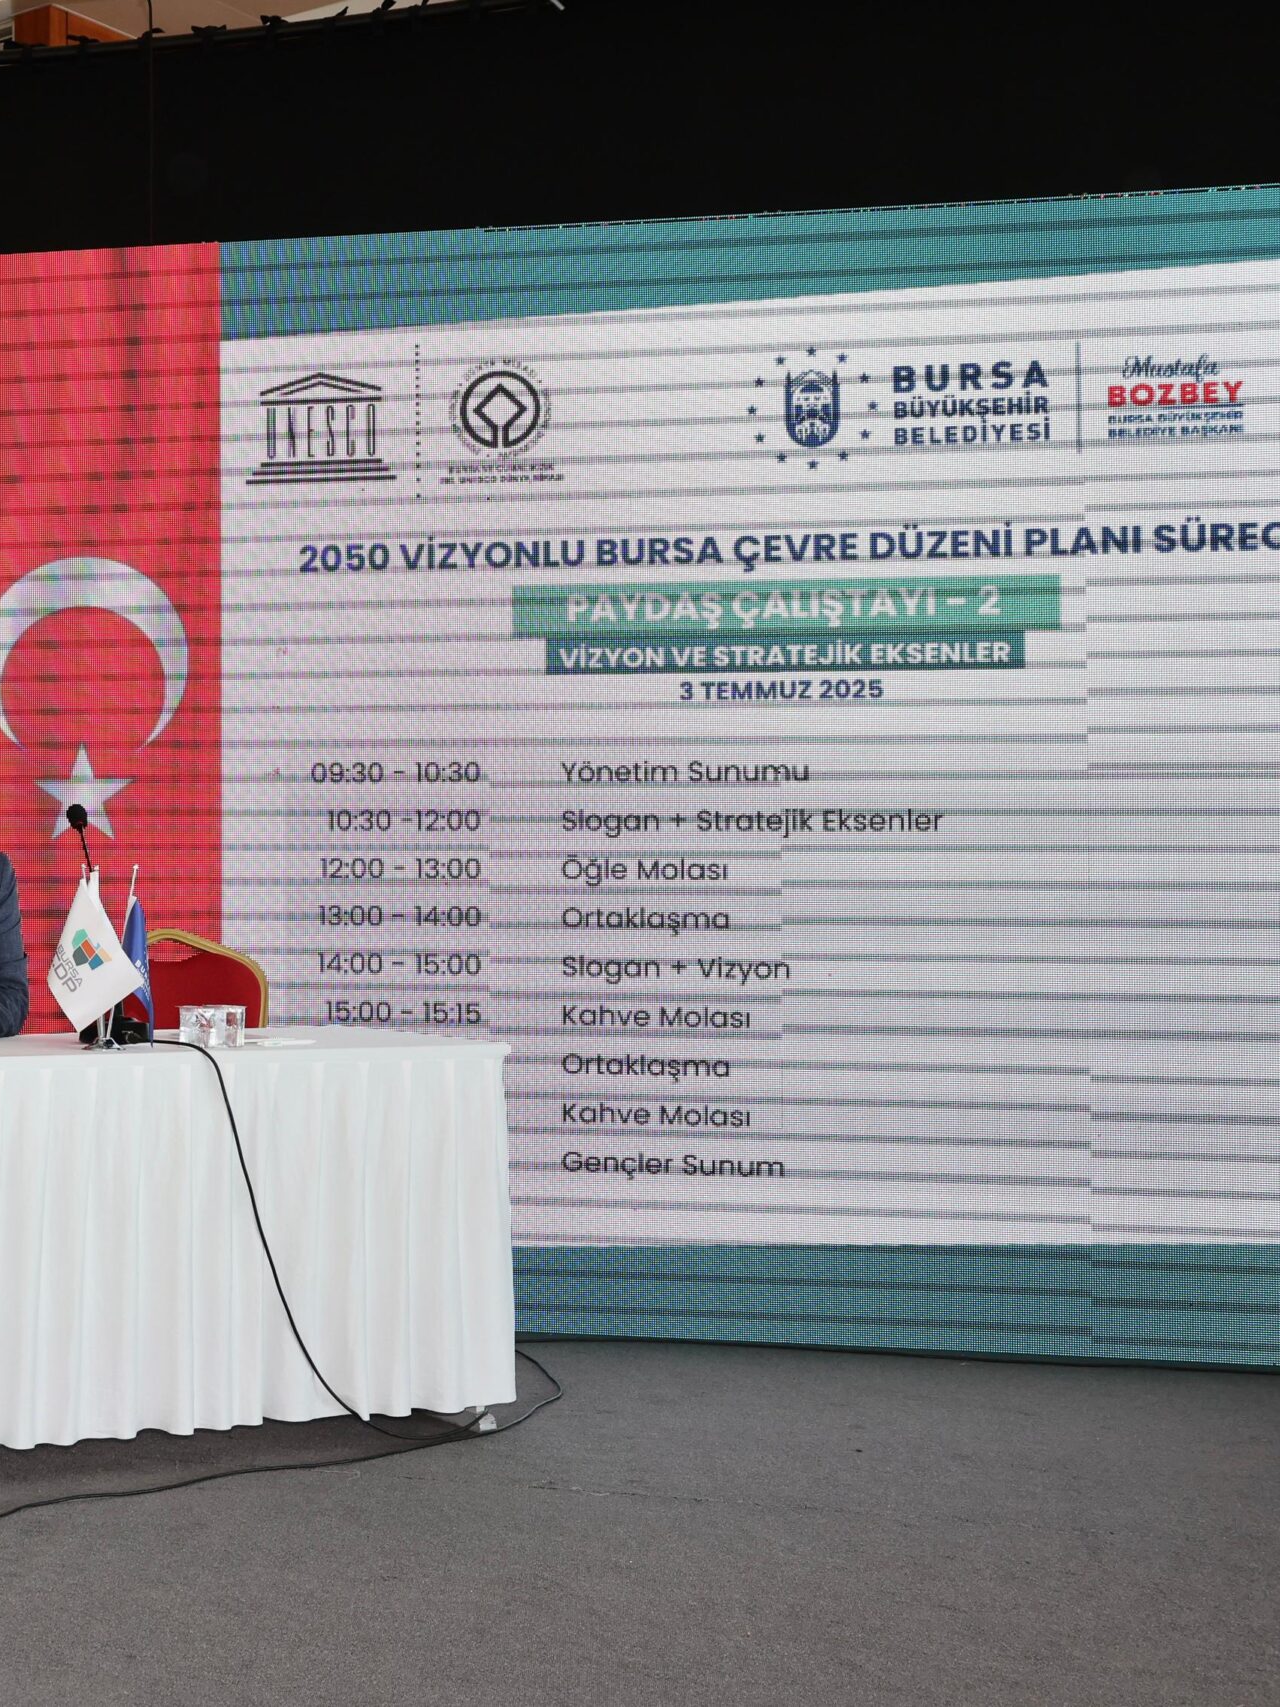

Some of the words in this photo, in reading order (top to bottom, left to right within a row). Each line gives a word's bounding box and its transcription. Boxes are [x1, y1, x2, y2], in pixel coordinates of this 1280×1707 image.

[893, 360, 1049, 393] BURSA
[1122, 353, 1220, 383] Mustafa
[1108, 381, 1244, 407] BOZBEY
[893, 395, 1049, 421] BÜYÜKŞEHİR
[266, 403, 376, 459] UNESCO
[893, 421, 1051, 446] BELEDİYESİ
[299, 543, 390, 573] 2050
[400, 536, 585, 570] VİZYONLU
[596, 537, 722, 567] BURSA
[733, 533, 858, 572] ÇEVRE
[869, 522, 1013, 560] DÜZENİ
[1024, 525, 1142, 557] PLANI
[566, 590, 724, 630] PAYDAŞ
[732, 587, 936, 629] ÇALIŞTAYI
[978, 585, 1001, 616] 2
[559, 643, 665, 669] VİZYON
[672, 646, 707, 667] VE
[714, 640, 863, 667] STRATEJİK
[871, 641, 1011, 665] EKSENLER
[680, 681, 694, 700] 3
[701, 680, 812, 700] TEMMUZ
[820, 679, 884, 699] 2025
[311, 762, 384, 784] 09:30
[415, 761, 481, 783] 10:30
[561, 761, 678, 783] Yönetim
[688, 761, 810, 783] Sunumu
[328, 809, 391, 831] 10:30
[561, 809, 659, 838] Slogan
[670, 813, 687, 827] +
[697, 809, 813, 838] Stratejik
[822, 808, 943, 832] Eksenler
[320, 857, 384, 879] 12:00
[415, 857, 481, 879] 13:00
[561, 854, 628, 887] Öğle
[637, 858, 728, 881] Molası
[318, 904, 382, 926] 13:00
[415, 905, 481, 927] 14:00
[561, 906, 730, 937] Ortaklaşma
[57, 944, 83, 988] BURSA
[318, 952, 382, 974] 14:00
[415, 953, 481, 975] 15:00
[561, 955, 661, 985] Slogan
[671, 960, 687, 975] +
[697, 956, 791, 986] Vizyon
[326, 1000, 391, 1023] 15:00
[423, 1002, 481, 1025] 15:15
[562, 1004, 651, 1027] Kahve
[660, 1005, 751, 1029] Molası
[561, 1052, 730, 1084] Ortaklaşma
[562, 1102, 651, 1126] Kahve
[660, 1103, 751, 1128] Molası
[561, 1151, 674, 1181] Gençler
[682, 1153, 785, 1178] Sunum
